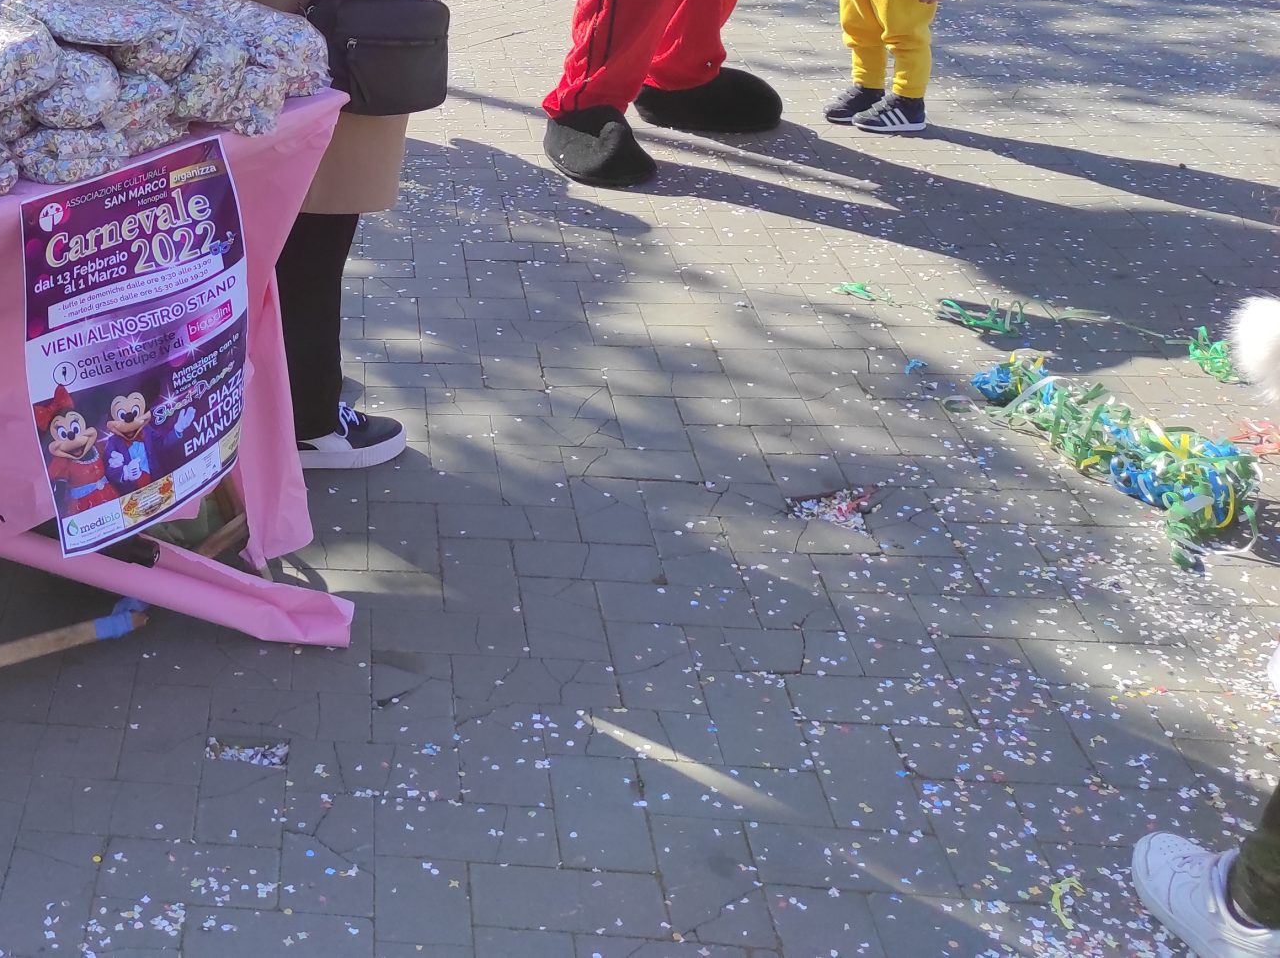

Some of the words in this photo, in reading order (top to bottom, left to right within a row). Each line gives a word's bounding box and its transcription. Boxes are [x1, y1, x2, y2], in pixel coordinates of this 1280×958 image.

[65, 182, 122, 209] ASSOCIAZIONE
[124, 166, 167, 189] CULTURALE
[173, 164, 217, 183] organizza
[104, 192, 126, 210] SAN
[128, 178, 167, 199] MARCO
[137, 191, 168, 207] Monopoli
[46, 189, 212, 268] Carnevale
[130, 221, 220, 274] 2022
[34, 273, 54, 294] dal
[56, 271, 70, 285] 13
[73, 251, 128, 279] Febbraio
[64, 279, 76, 295] al
[78, 277, 85, 289] 1
[88, 264, 127, 286] Marzo
[126, 280, 145, 293] dalle
[146, 277, 159, 286] ore
[178, 265, 192, 278] alle
[94, 298, 119, 312] grasso
[120, 290, 139, 302] dalle
[140, 288, 152, 297] ore
[175, 277, 189, 288] alle
[40, 333, 83, 357] VIENI
[86, 324, 110, 344] AL
[111, 303, 184, 336] NOSTRO
[187, 275, 236, 312] STAND
[78, 354, 100, 369] con
[103, 350, 116, 363] le
[118, 331, 176, 357] interviste
[80, 363, 114, 380] della
[115, 350, 157, 370] troupe
[159, 345, 172, 357] tv
[173, 338, 184, 350] di
[172, 350, 218, 381] Animazione
[219, 341, 232, 354] con
[232, 333, 239, 343] le
[173, 357, 218, 388] MASCOTTE
[208, 369, 243, 408] PIAZZ
[184, 400, 243, 457] EMANUEL
[193, 384, 243, 434] VITTORI
[80, 513, 120, 534] medibio
